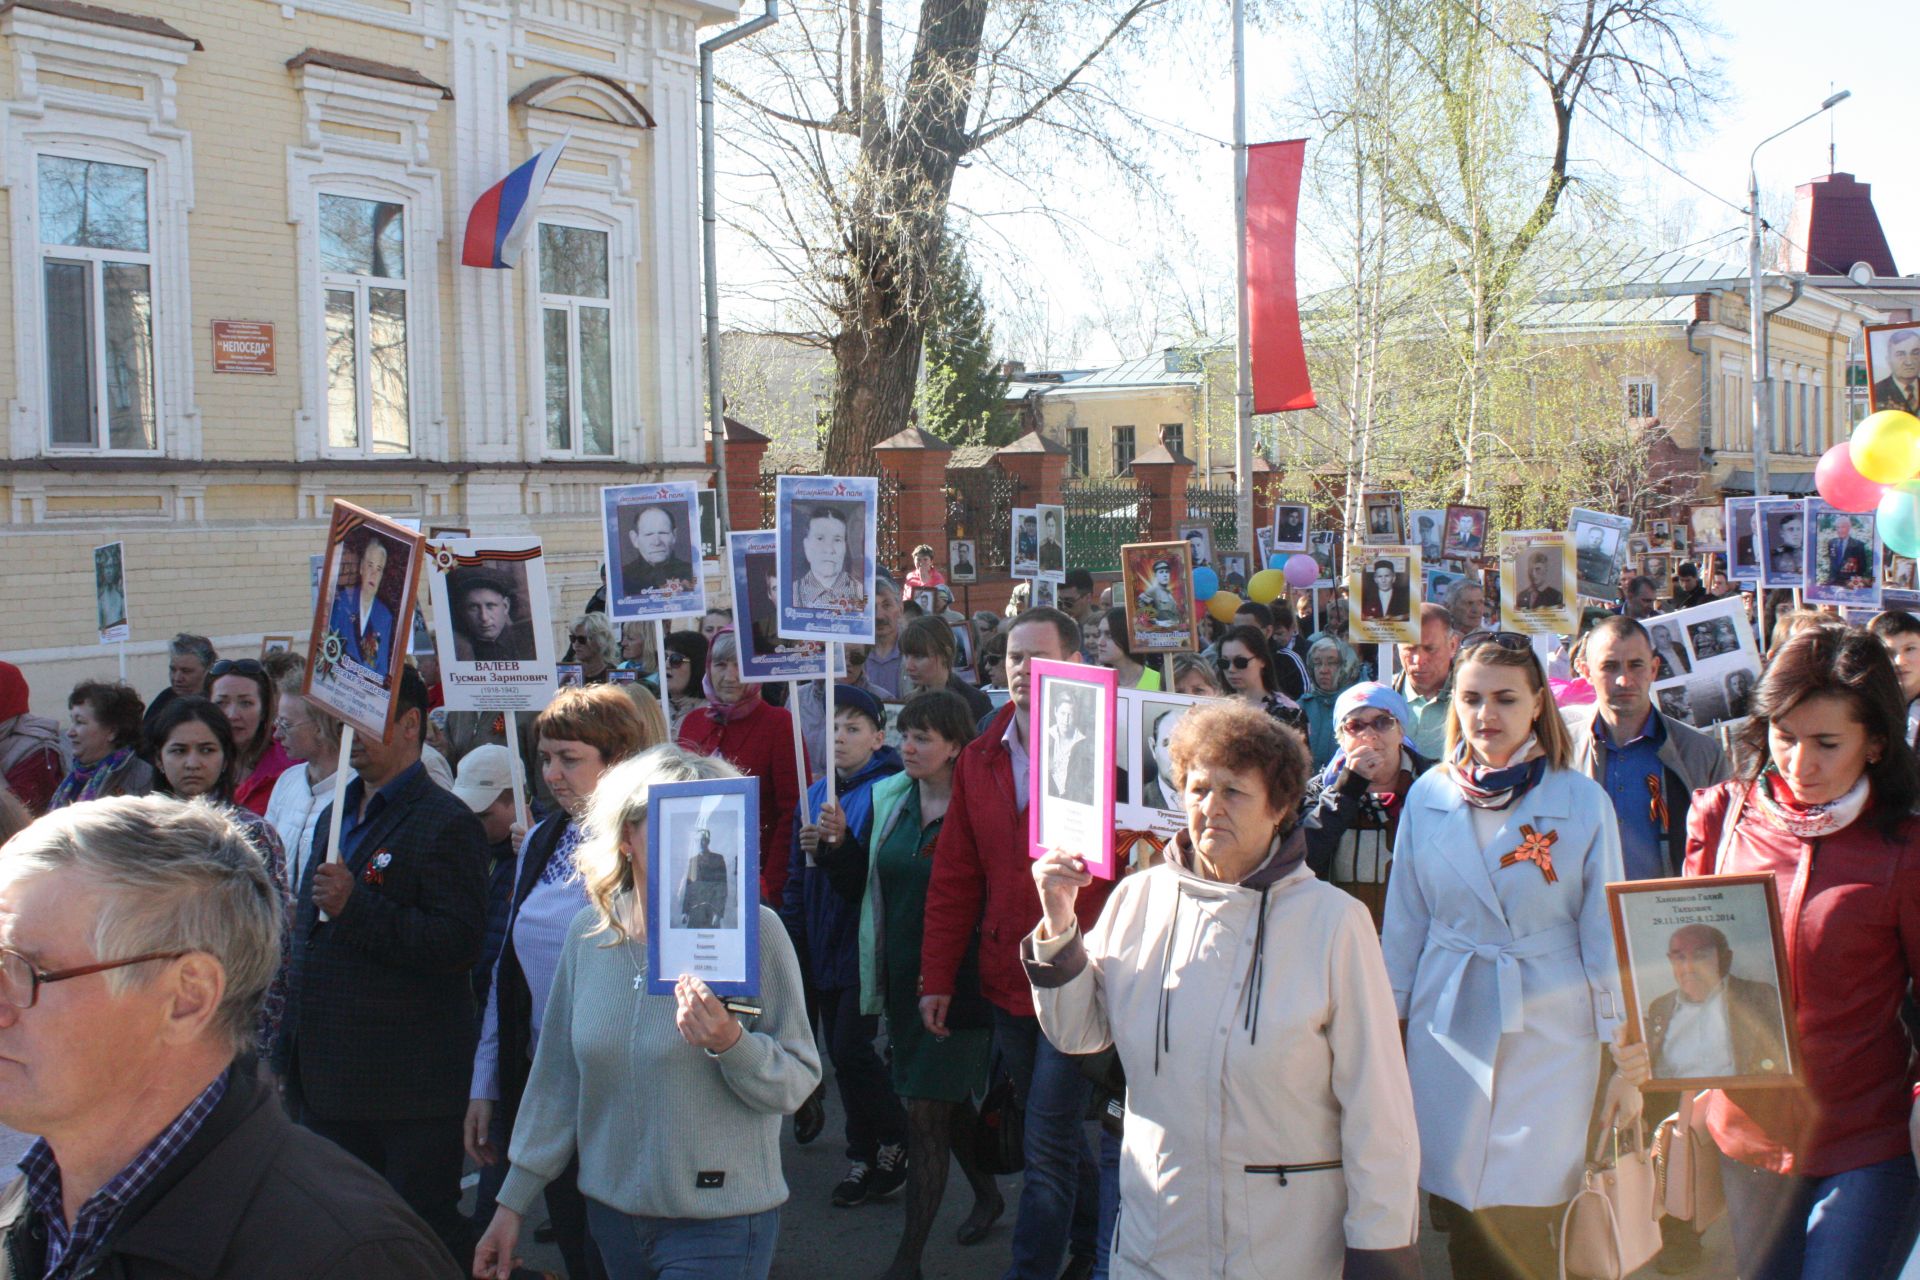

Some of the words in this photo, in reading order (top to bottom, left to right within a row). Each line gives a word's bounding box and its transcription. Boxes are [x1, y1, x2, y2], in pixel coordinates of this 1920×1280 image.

[475, 661, 520, 671] ВАЛЕЕВ
[449, 672, 486, 684] Гусман
[490, 672, 548, 683] Зарипович
[480, 686, 520, 694] (1918-1942)
